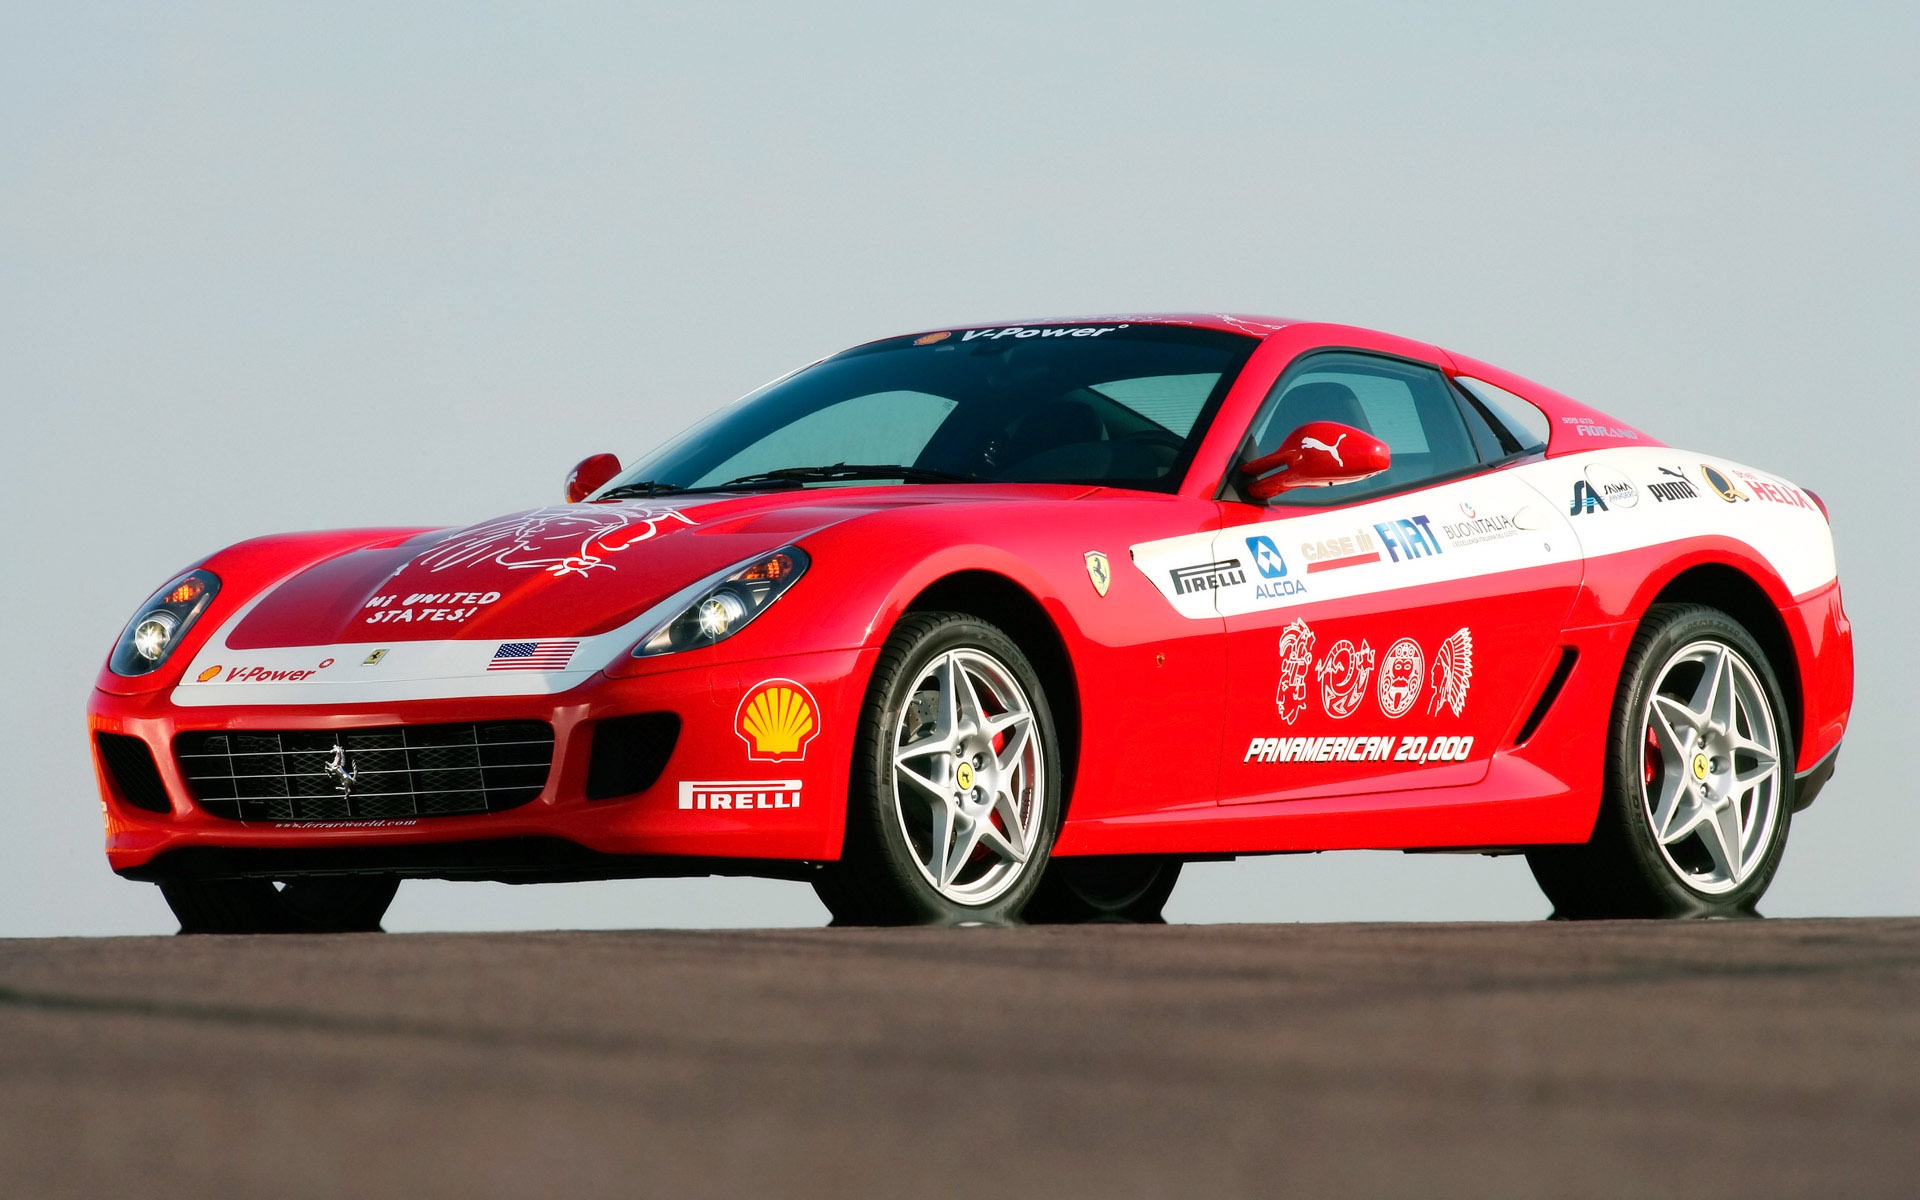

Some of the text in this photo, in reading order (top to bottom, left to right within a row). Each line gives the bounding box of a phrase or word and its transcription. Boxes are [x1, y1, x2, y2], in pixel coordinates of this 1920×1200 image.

[961, 324, 1116, 341] V-Power
[1561, 417, 1578, 425] 599
[1576, 425, 1638, 440] FIORANO
[1647, 481, 1697, 502] PUMA
[1744, 480, 1814, 511] HELIX
[1443, 515, 1513, 540] BUONITALIA
[1301, 536, 1355, 561] CASE
[1373, 514, 1443, 563] FIAT
[1169, 558, 1246, 595] PIRELLI
[402, 591, 501, 606] UNITED
[1256, 579, 1307, 599] ALCOA
[366, 607, 478, 624] STATES!
[225, 666, 316, 682] V-Power
[1243, 736, 1474, 765] PANAMERICAN 20,000
[679, 779, 803, 810] PIRELLI
[275, 819, 417, 829] www.ferrariworld.com
